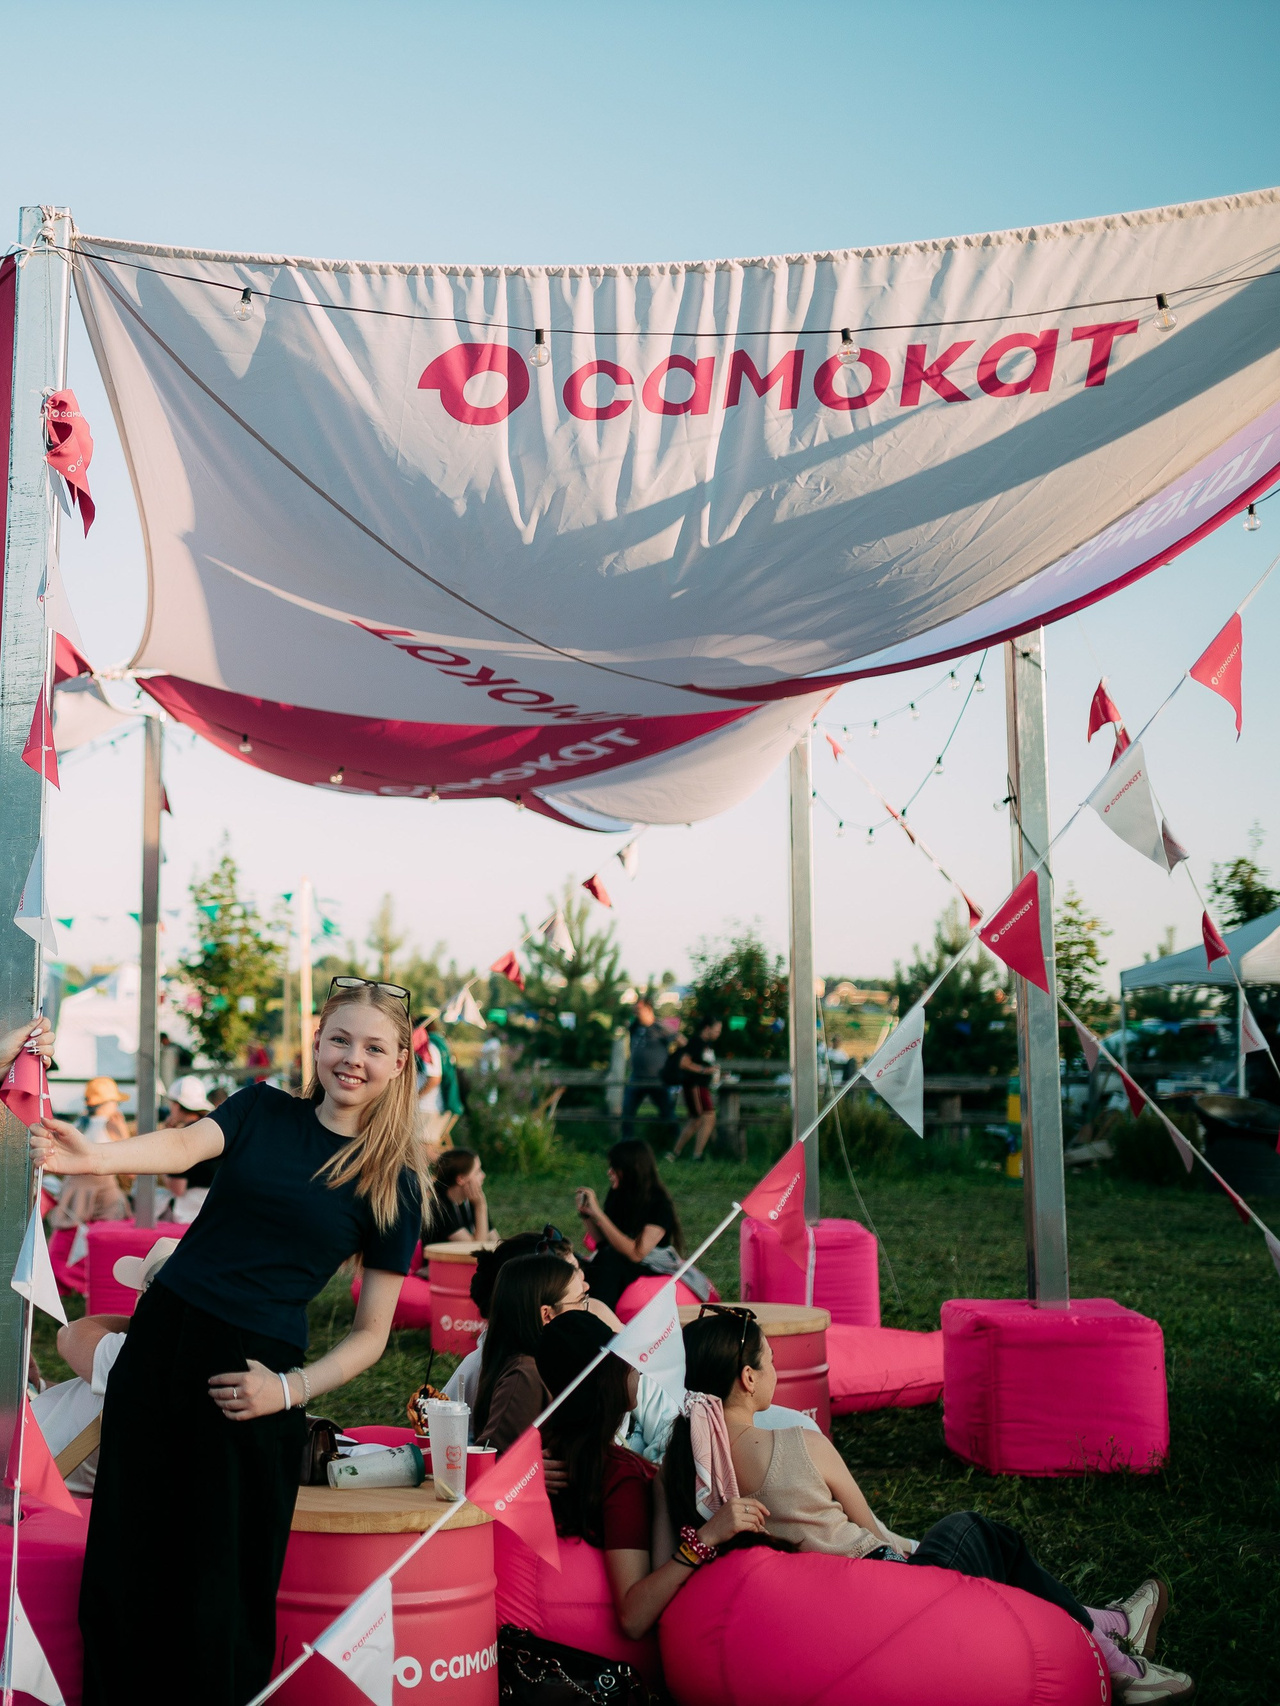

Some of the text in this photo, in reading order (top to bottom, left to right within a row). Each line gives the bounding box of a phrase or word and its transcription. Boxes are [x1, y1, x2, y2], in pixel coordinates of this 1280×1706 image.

[562, 320, 1138, 421] самокат
[999, 899, 1034, 935] самокат
[505, 1462, 540, 1503] самокат
[352, 1611, 388, 1653] самокат
